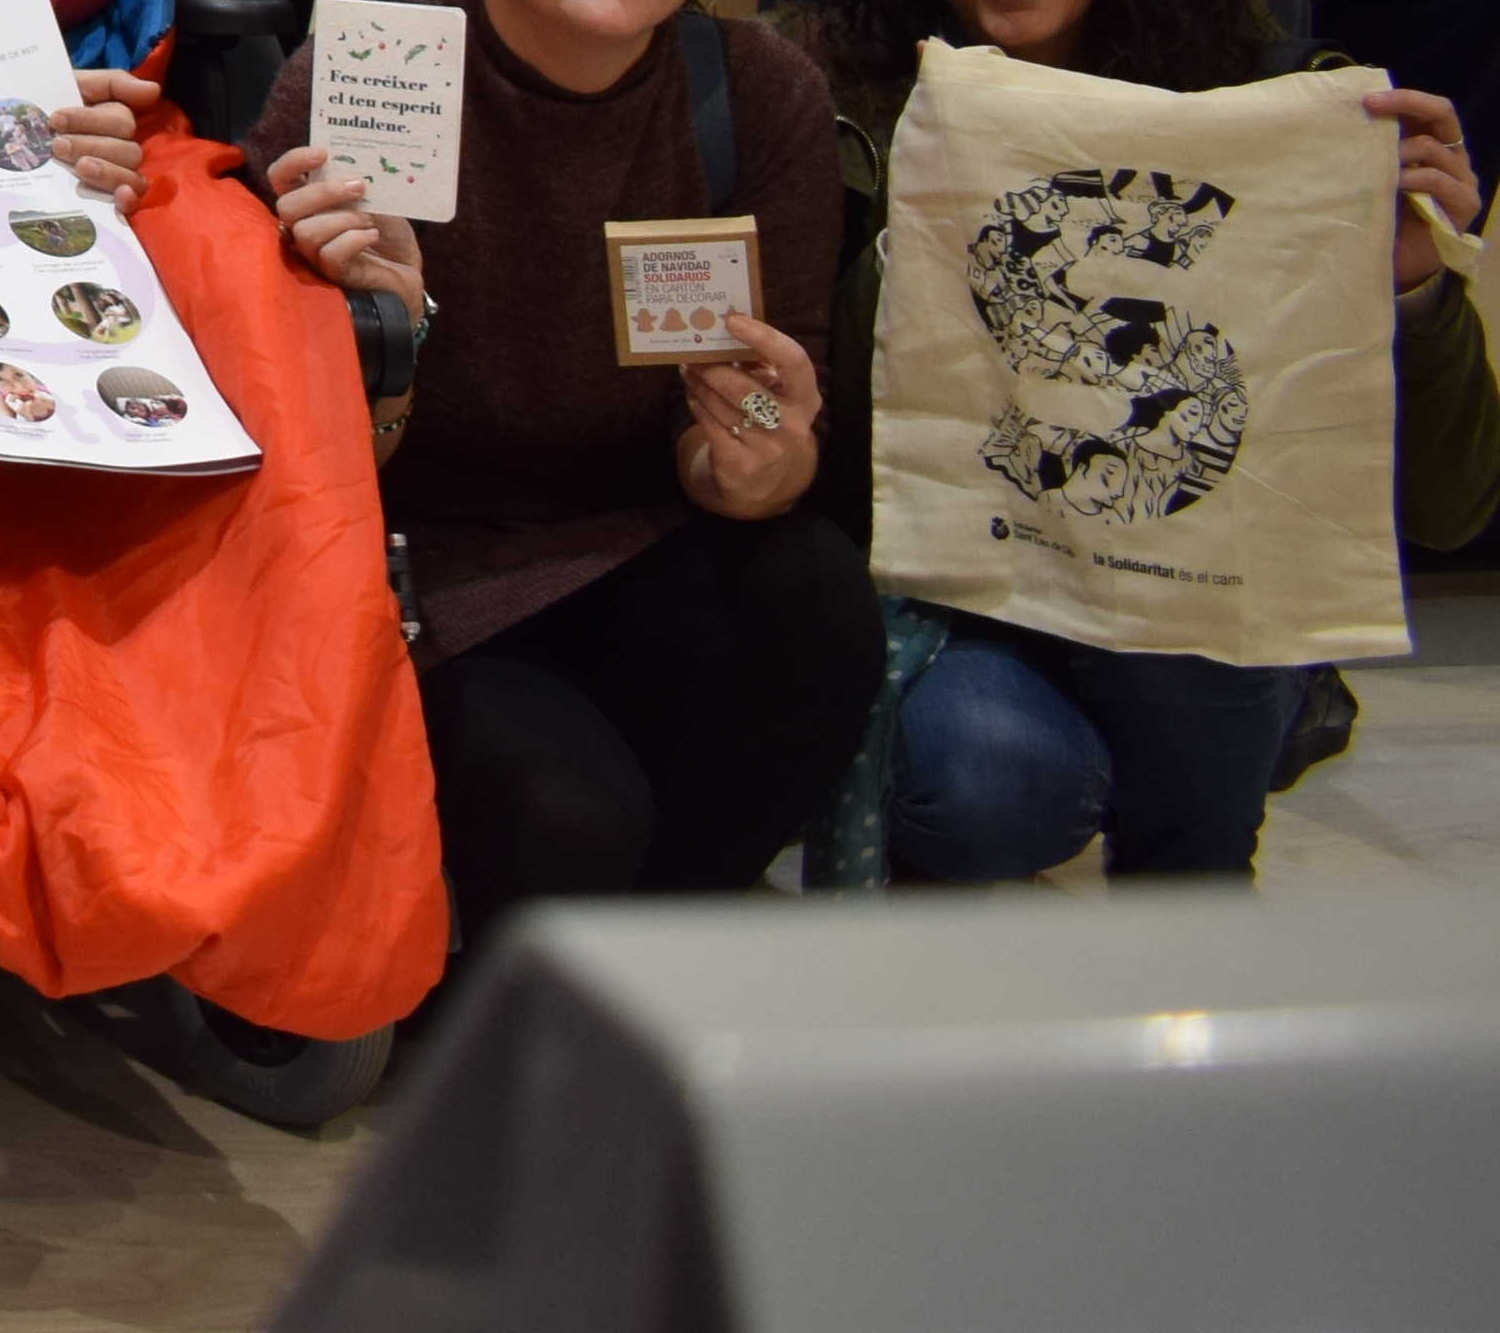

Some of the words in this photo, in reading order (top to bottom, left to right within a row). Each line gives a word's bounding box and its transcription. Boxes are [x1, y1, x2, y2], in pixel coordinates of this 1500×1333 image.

[329, 69, 359, 85] Fes
[362, 73, 429, 92] créixer
[328, 91, 345, 105] el
[349, 94, 376, 109] teu
[381, 101, 444, 117] esperit
[642, 249, 697, 262] ADORNOS
[643, 262, 659, 273] DE
[660, 260, 711, 273] NAVIDAD
[643, 271, 711, 284] SOLIDARIOS
[645, 294, 674, 305] PARA
[676, 291, 727, 304] DECORAR
[1093, 552, 1105, 566] la
[1107, 555, 1175, 580] Solidaritat
[1196, 570, 1209, 584] el
